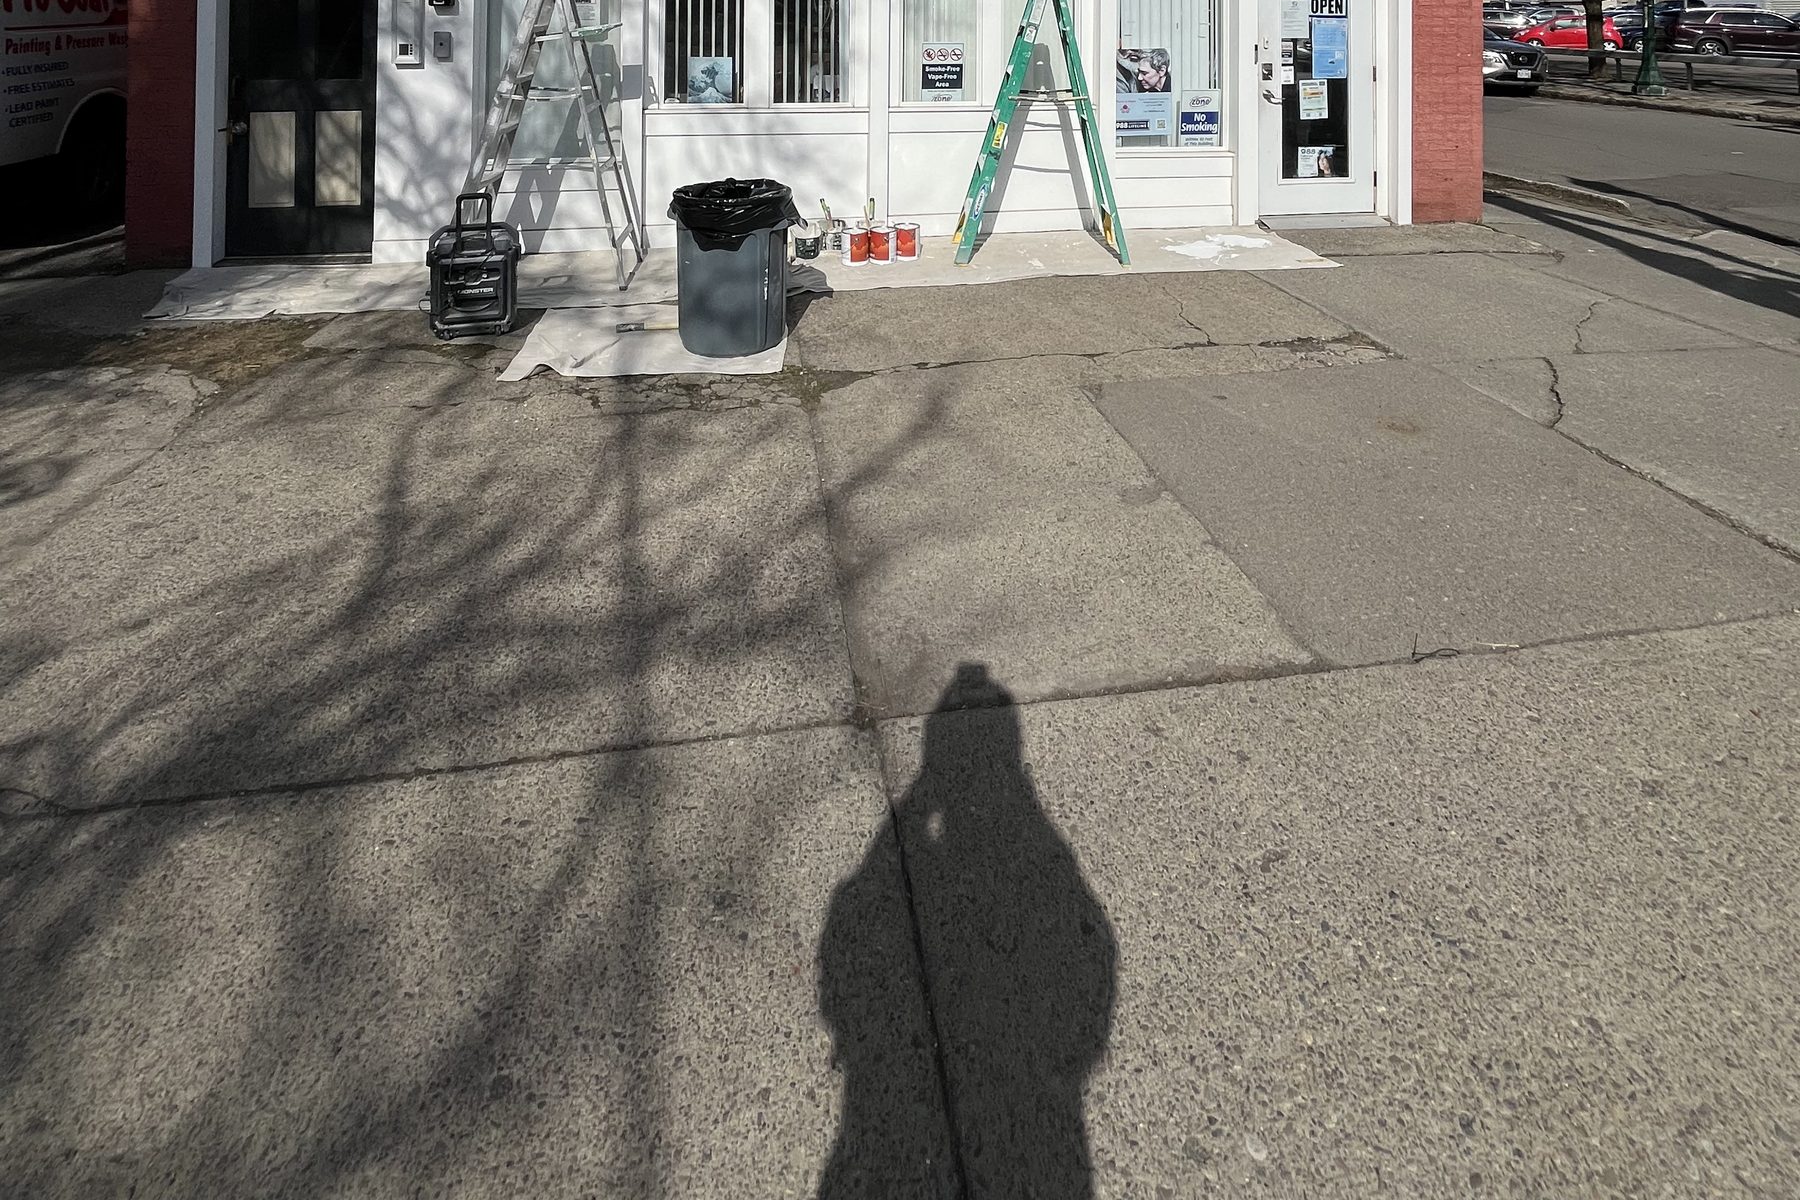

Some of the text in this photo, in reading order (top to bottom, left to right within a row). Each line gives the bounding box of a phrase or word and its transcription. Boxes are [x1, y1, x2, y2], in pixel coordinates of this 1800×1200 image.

[5, 36, 51, 56] Painting
[55, 34, 62, 50] &
[66, 34, 105, 49] Pressure
[6, 61, 69, 76] FULLY INSURED
[8, 78, 75, 94] FREE ESTIMATES
[9, 97, 60, 114] LEAD PAINT
[9, 112, 54, 127] CERTIFIED
[1193, 113, 1206, 122] No
[1181, 122, 1217, 133] Smoking
